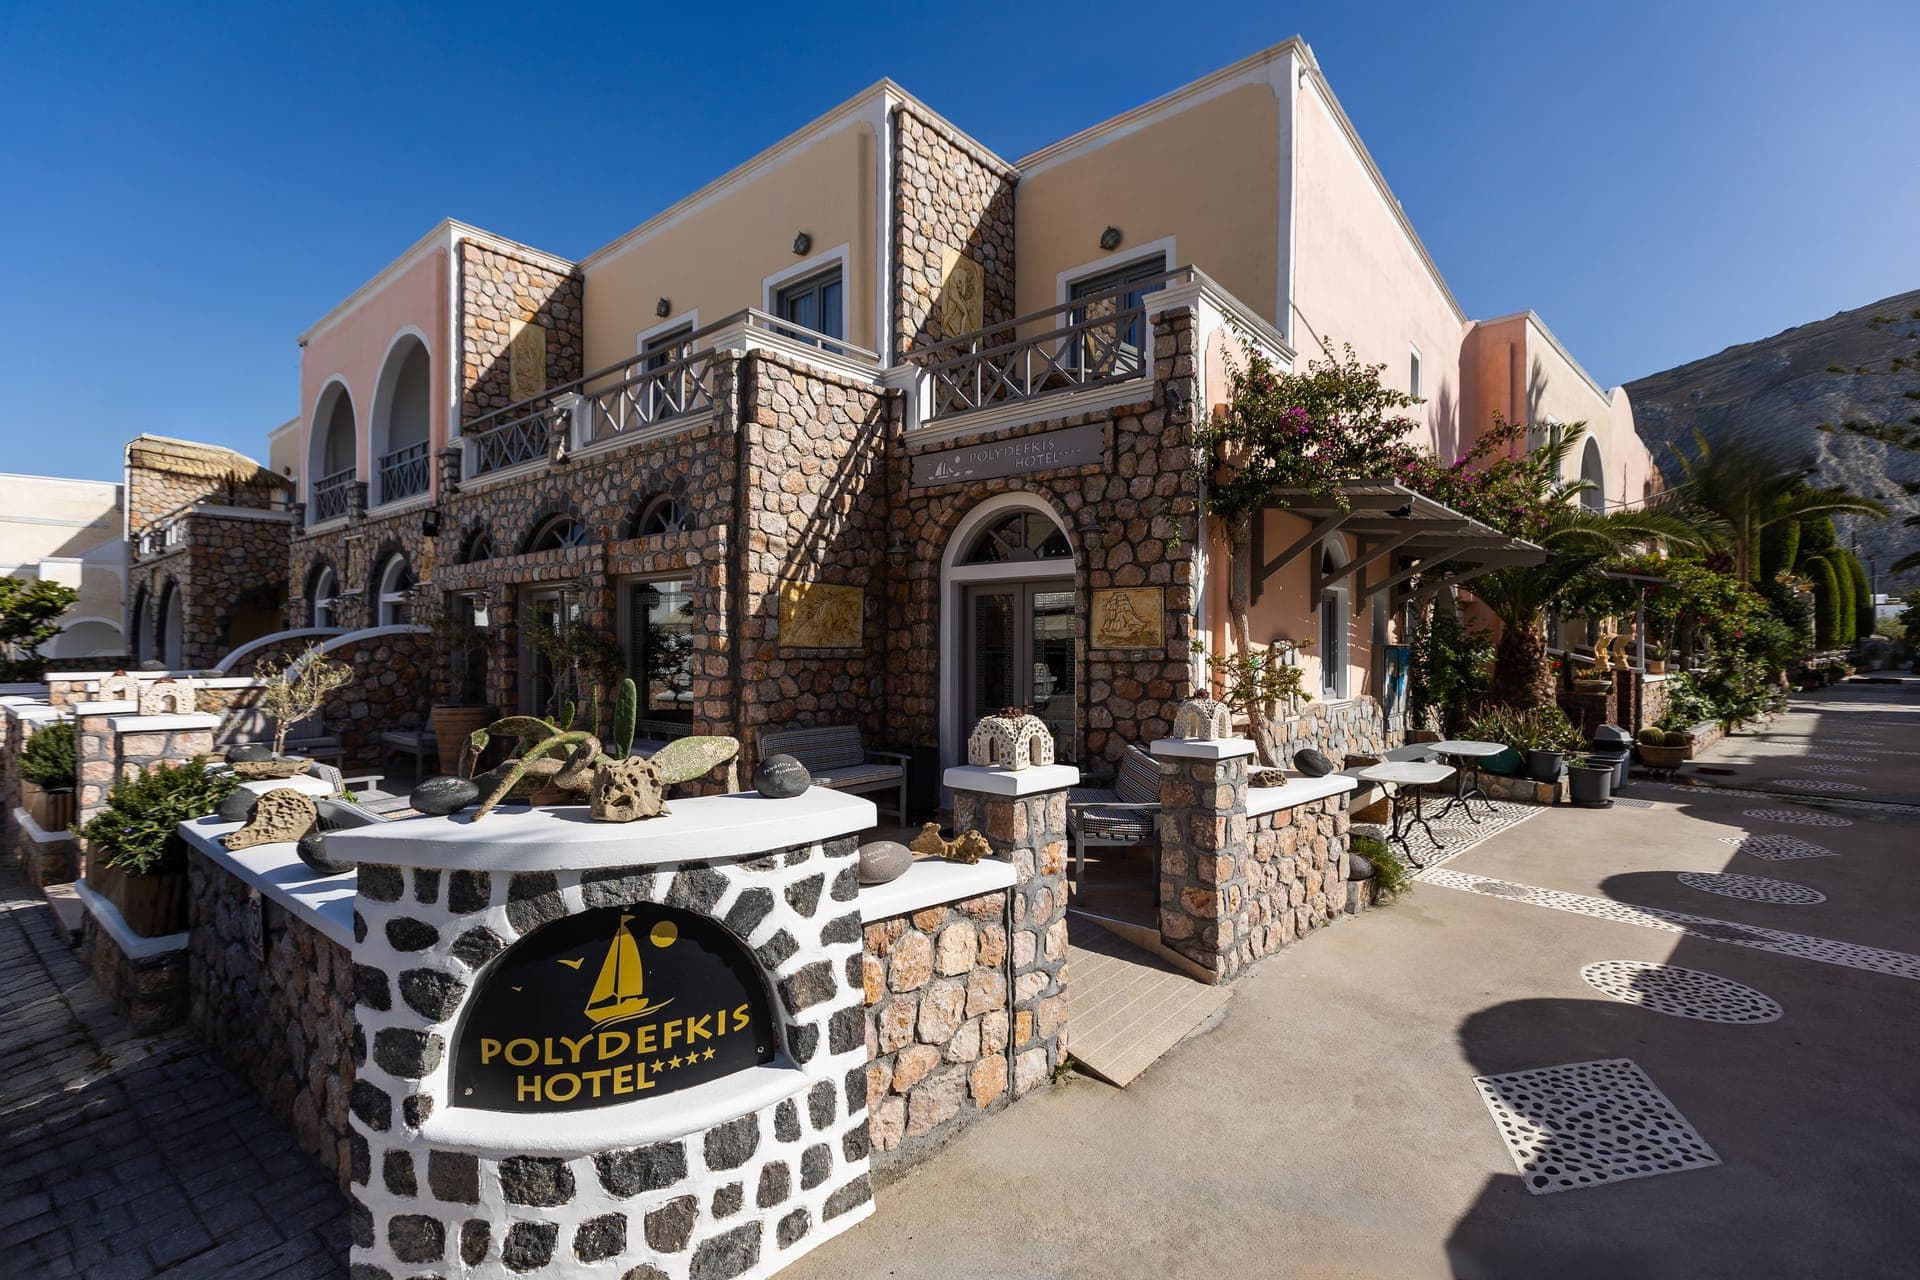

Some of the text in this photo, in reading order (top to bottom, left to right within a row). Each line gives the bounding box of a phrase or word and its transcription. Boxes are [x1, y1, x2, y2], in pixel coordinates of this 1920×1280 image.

[969, 439, 1055, 463] POLYDEFKIS
[1015, 451, 1059, 468] HOTEL
[480, 1003, 750, 1066] POLYDEFKIS
[516, 1062, 656, 1102] HOTEL
